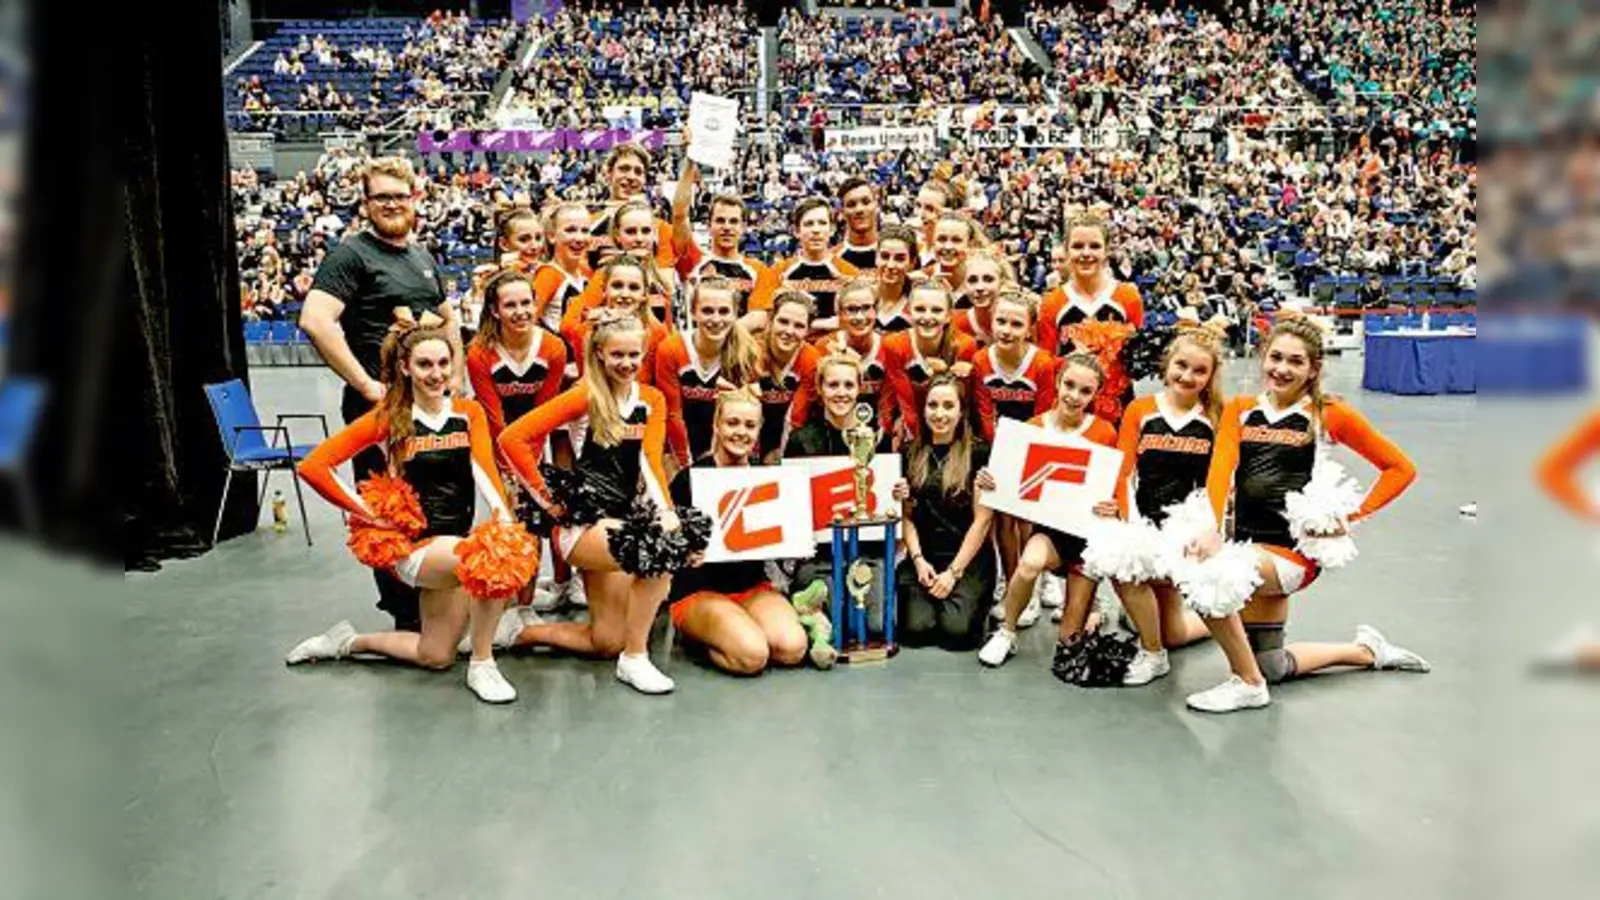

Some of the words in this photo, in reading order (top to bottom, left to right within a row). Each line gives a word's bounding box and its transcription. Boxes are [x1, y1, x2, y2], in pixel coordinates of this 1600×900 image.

[972, 126, 1018, 146] ROUD
[810, 467, 878, 531] B
[1020, 443, 1092, 502] F
[718, 481, 783, 552] C
